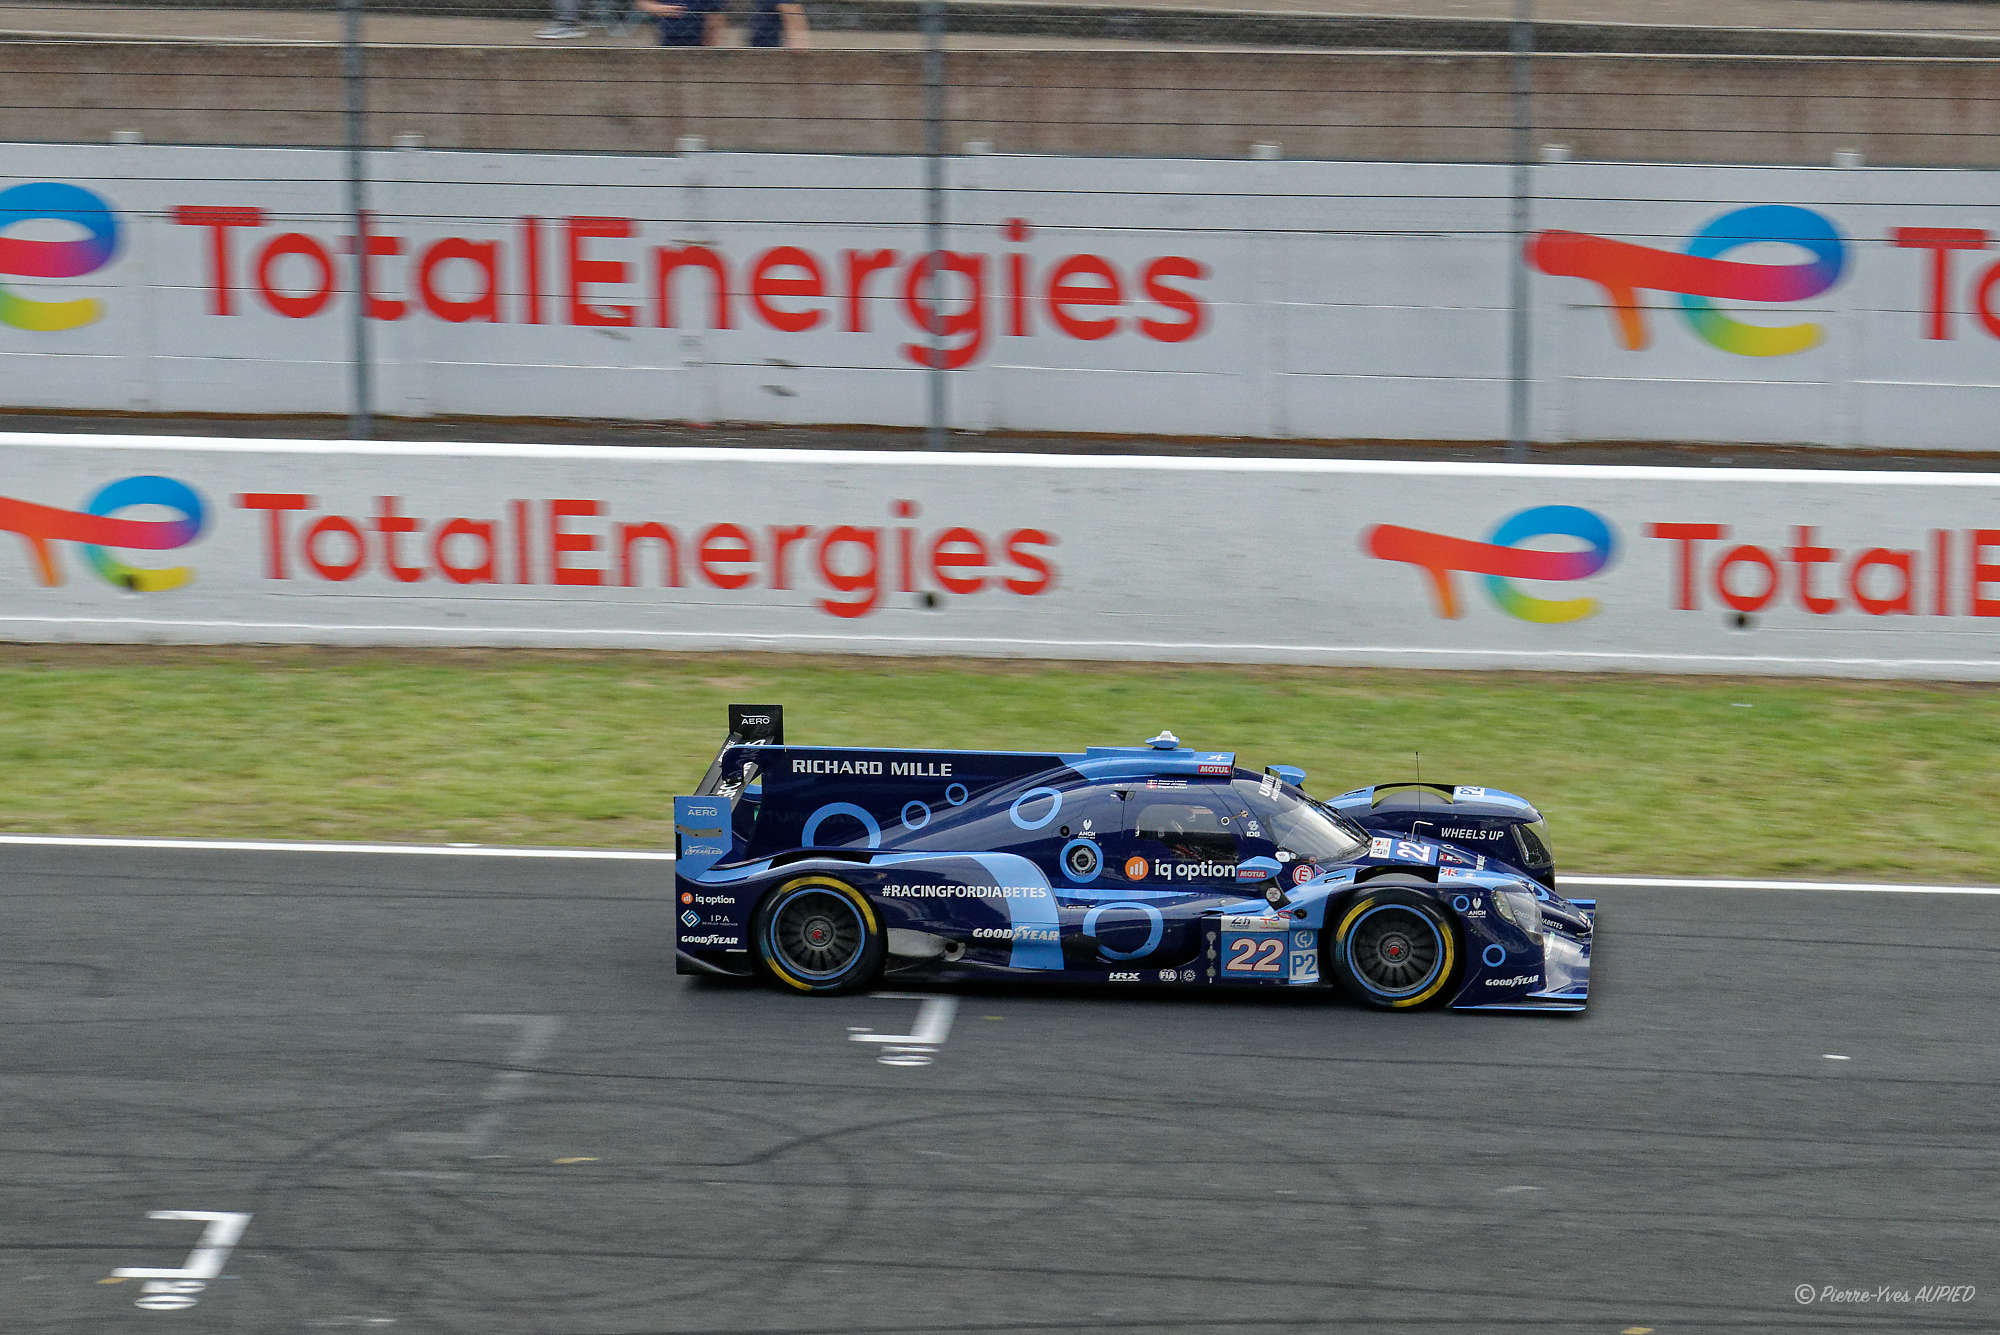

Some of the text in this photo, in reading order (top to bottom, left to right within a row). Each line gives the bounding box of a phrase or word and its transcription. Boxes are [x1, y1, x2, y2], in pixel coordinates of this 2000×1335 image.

[170, 204, 1210, 370] TotalEnergies
[237, 492, 1057, 618] TotalEnergies
[741, 717, 770, 725] AERO
[792, 759, 953, 777] RICHARD MILLE
[1200, 765, 1230, 774] MOTUL
[687, 809, 718, 817] AERO
[1441, 827, 1505, 841] WHEELS UP
[1396, 841, 1431, 863] 22
[1155, 858, 1236, 880] iq option
[1298, 869, 1309, 882] E
[882, 885, 1047, 898] #RACINGFORDIABETES
[695, 893, 736, 905] iq option
[710, 914, 730, 923] IPA
[681, 934, 739, 945] GOODYEAR
[972, 926, 1060, 941] GOODYEAR
[1225, 938, 1285, 972] 22
[1292, 953, 1317, 976] P2
[1160, 970, 1176, 980] FIA
[1485, 974, 1539, 987] GOODYEAR
